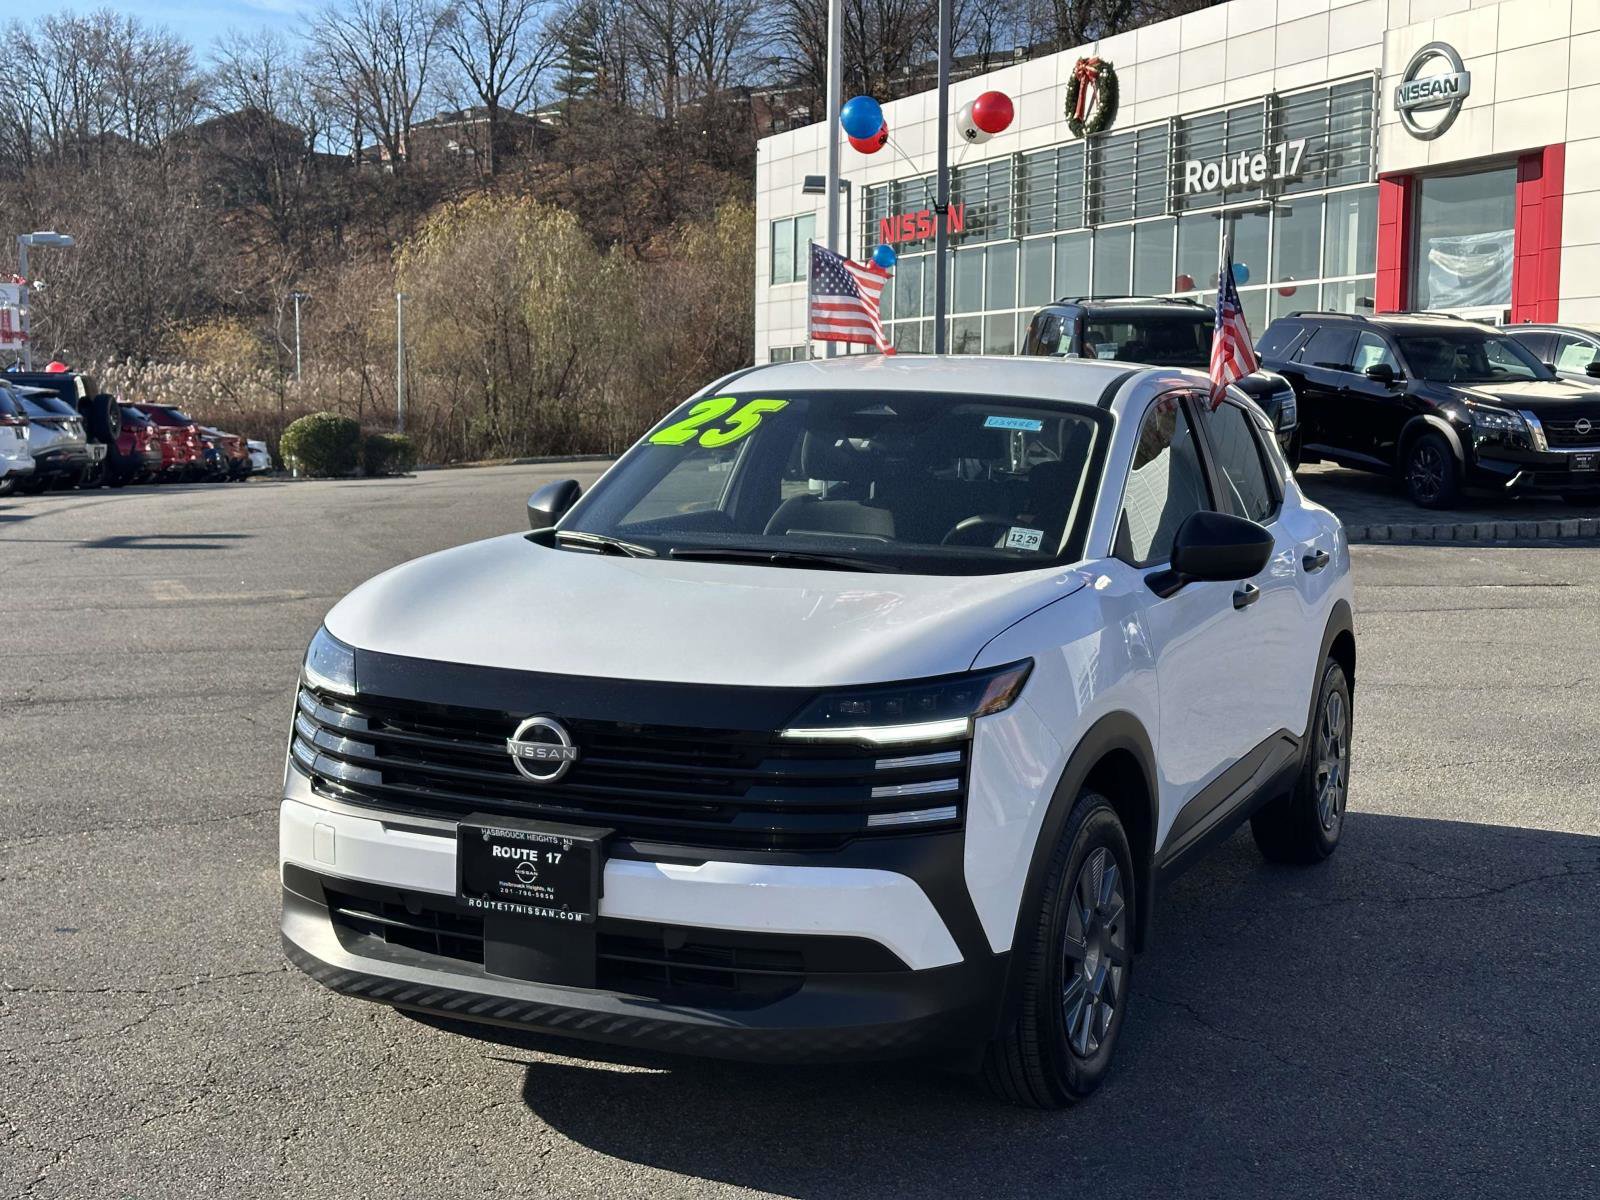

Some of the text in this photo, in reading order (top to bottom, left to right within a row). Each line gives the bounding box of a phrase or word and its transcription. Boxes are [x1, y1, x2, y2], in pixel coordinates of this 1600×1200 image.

[1398, 77, 1459, 103] NISSAN
[1184, 138, 1306, 193] Route 17
[648, 397, 790, 449] 25
[1011, 533, 1023, 543] 12
[1026, 535, 1038, 545] 29
[508, 742, 575, 759] NISSAN
[481, 828, 525, 840] HASBROUCK
[563, 838, 573, 846] NJ
[492, 845, 562, 865] ROUTE 17
[468, 899, 583, 922] ROUTE17NISSAN.COM
